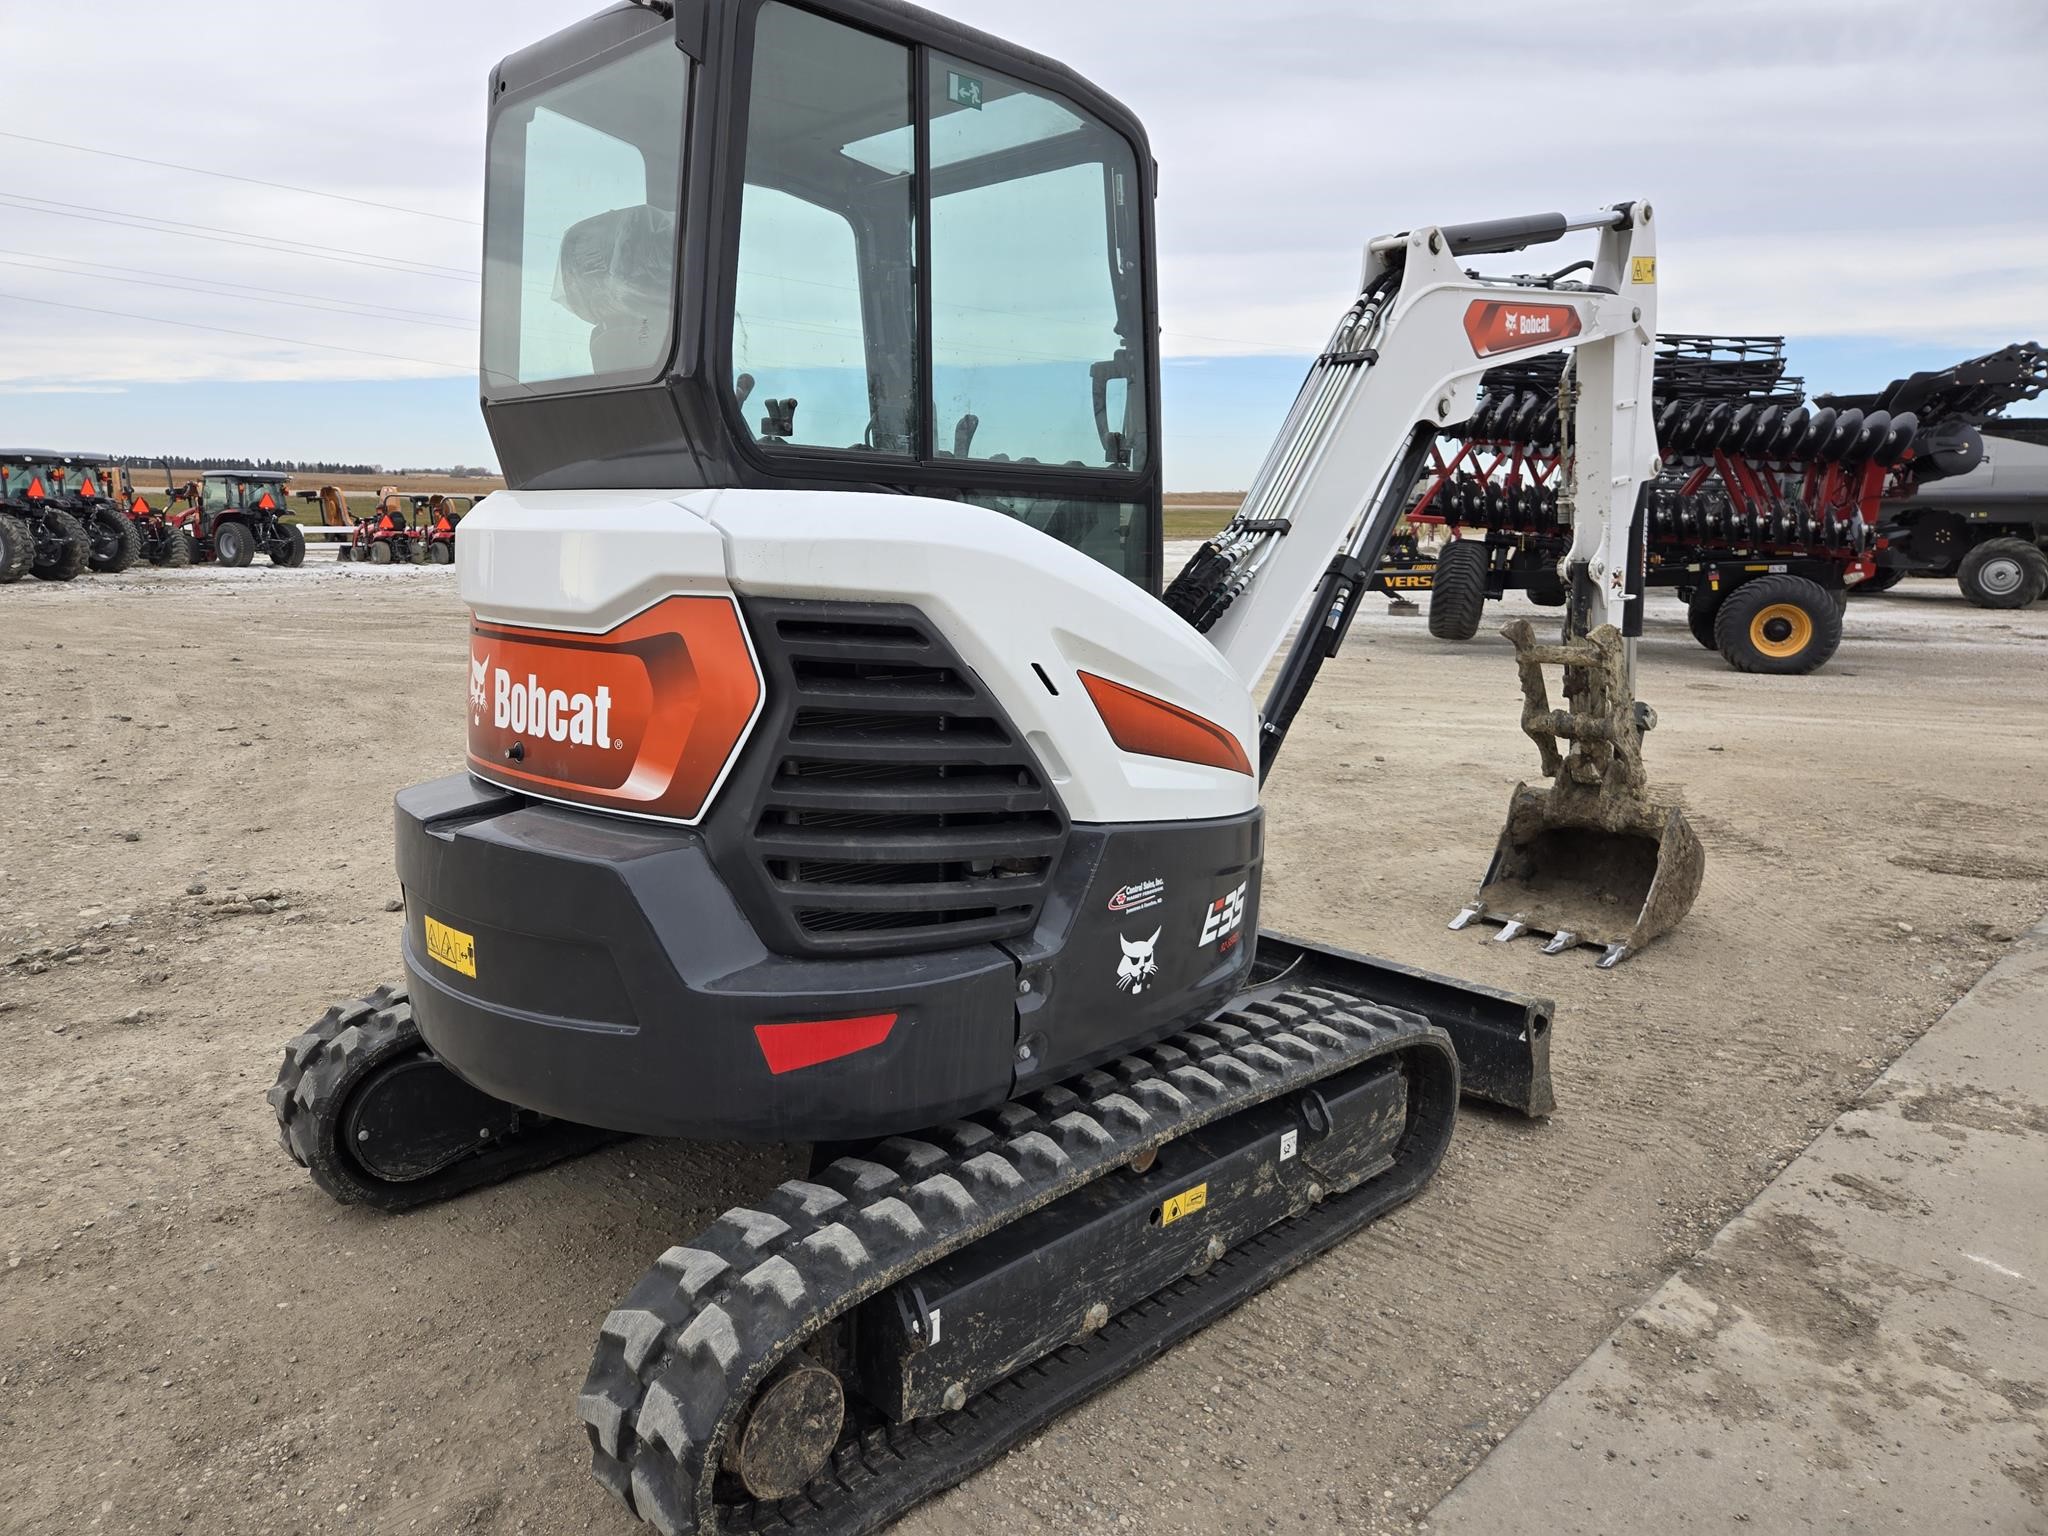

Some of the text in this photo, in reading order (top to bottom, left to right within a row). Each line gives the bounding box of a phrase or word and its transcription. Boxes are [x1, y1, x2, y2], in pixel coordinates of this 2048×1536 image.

[1520, 314, 1551, 334] Bobcat
[1385, 576, 1435, 587] VERS
[494, 668, 612, 750] Bobcat
[1126, 883, 1143, 895] Central
[1198, 880, 1247, 948] E35
